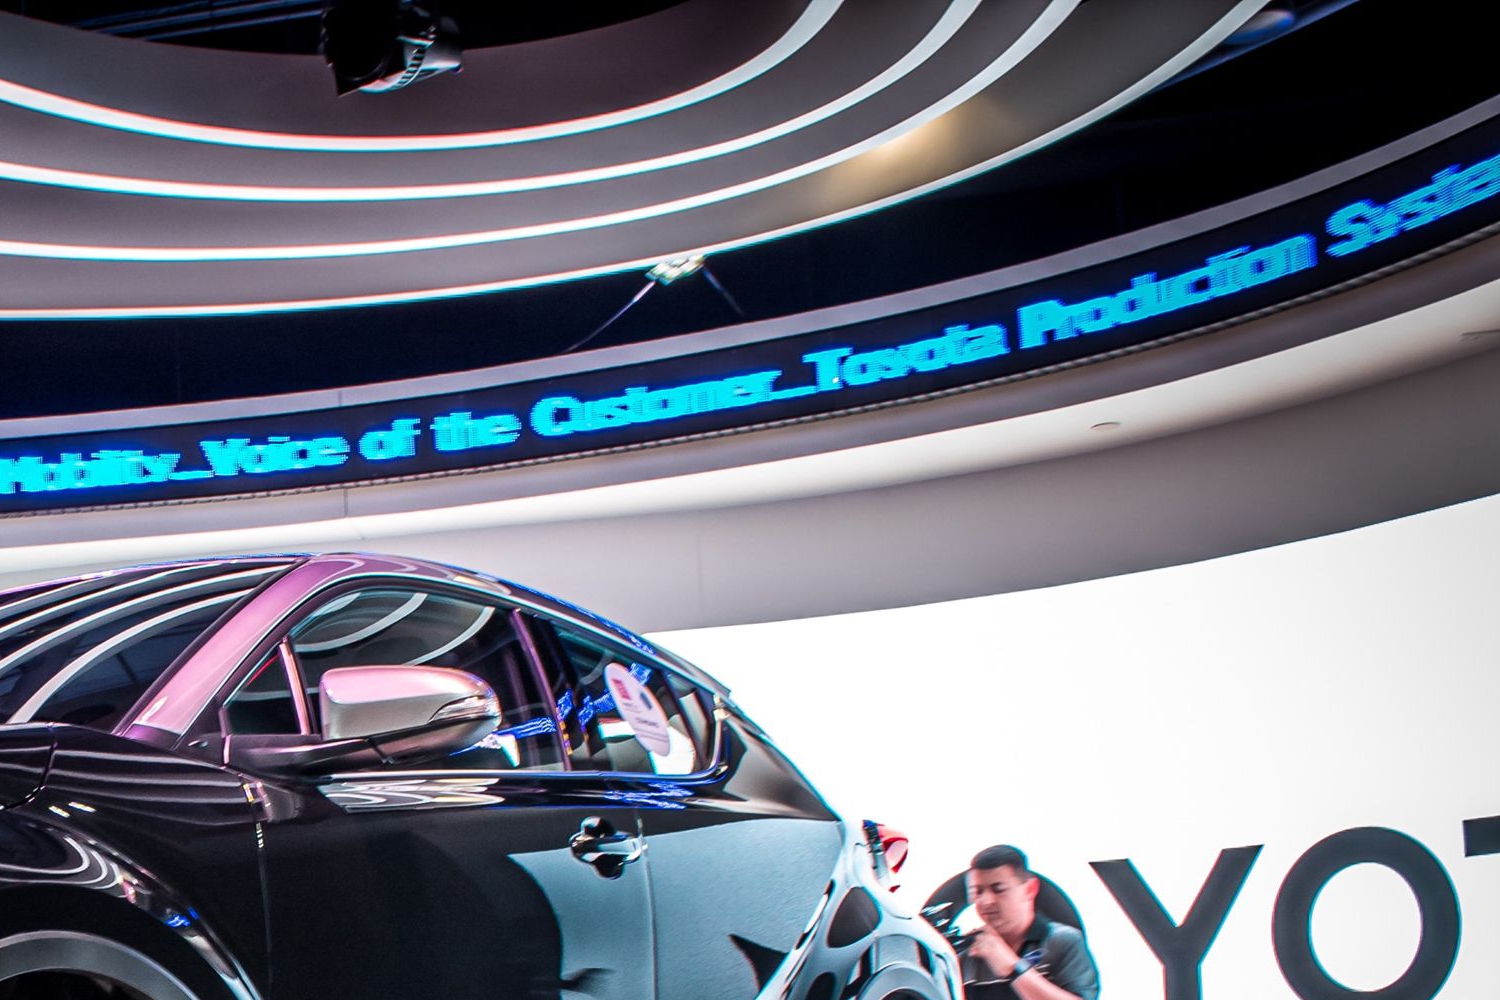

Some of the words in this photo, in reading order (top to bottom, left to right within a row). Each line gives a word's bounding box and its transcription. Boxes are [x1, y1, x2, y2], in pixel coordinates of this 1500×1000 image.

[359, 418, 421, 460] of
[430, 411, 521, 451] the
[1016, 233, 1318, 349] Production
